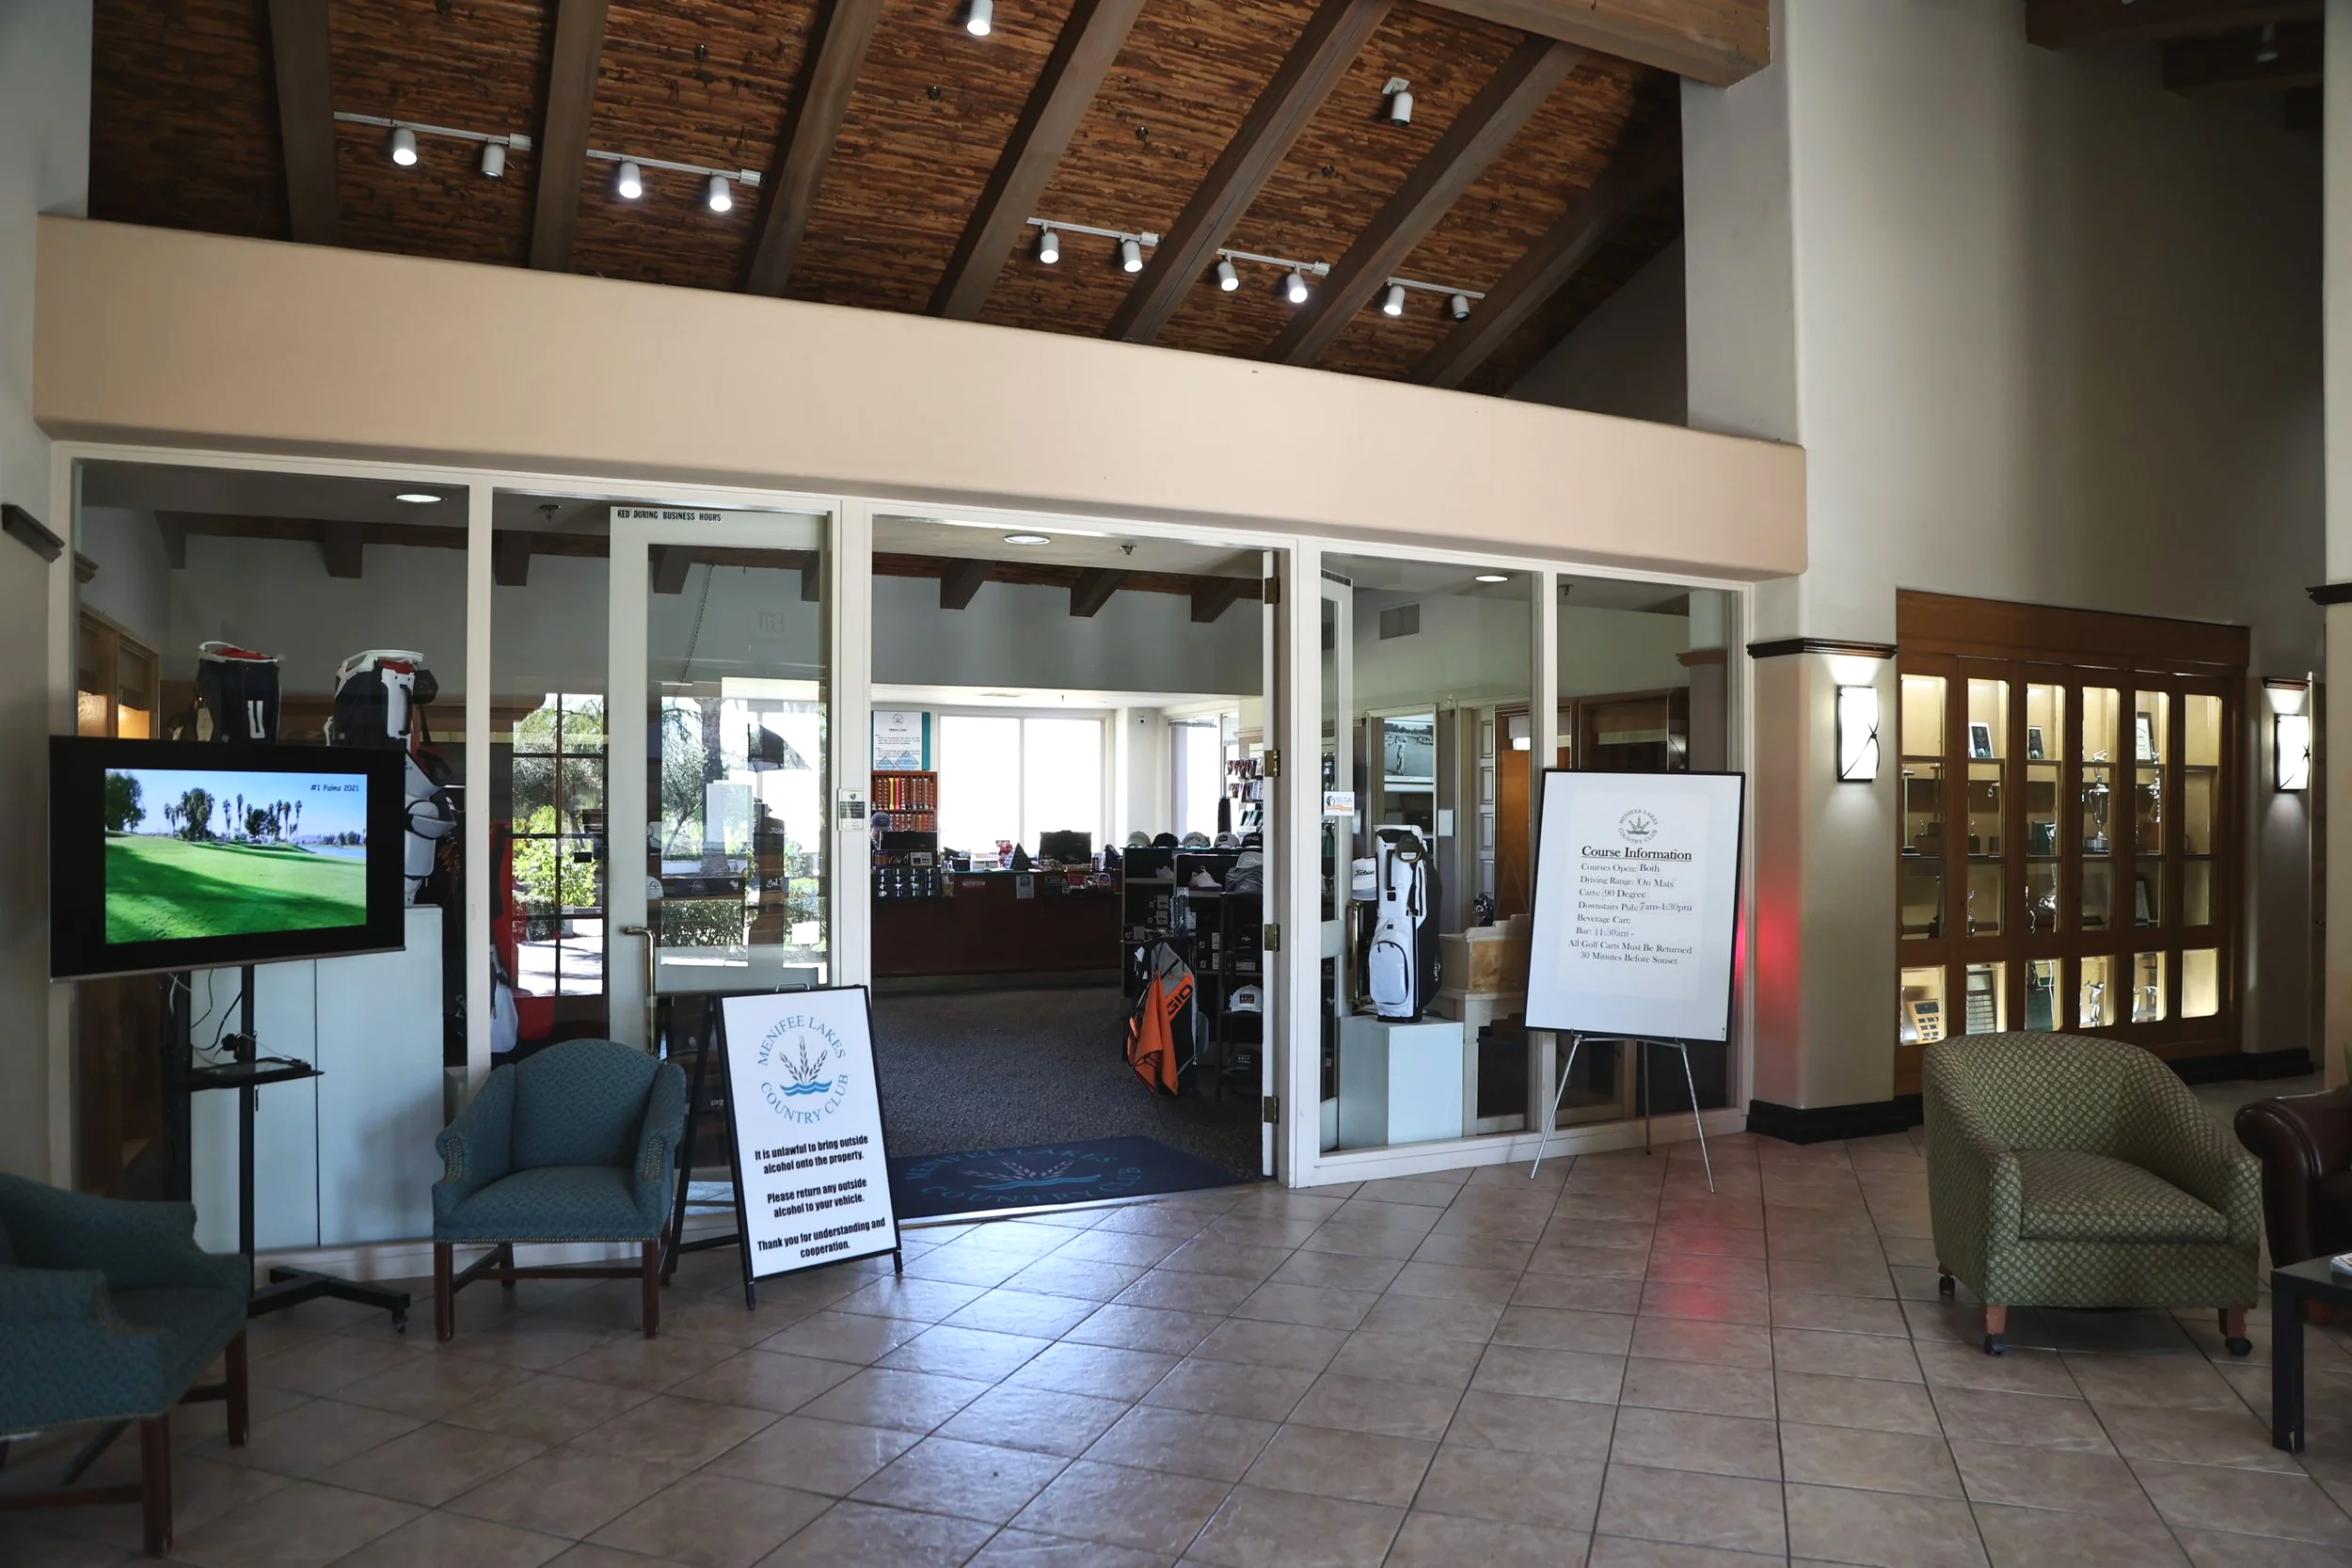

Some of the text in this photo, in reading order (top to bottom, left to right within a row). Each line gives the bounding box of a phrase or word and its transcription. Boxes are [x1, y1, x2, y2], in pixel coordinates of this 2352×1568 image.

[617, 510, 722, 522] KED DURING BUSINESS HOURS
[323, 784, 341, 792] Palms
[343, 784, 359, 792] 2021
[1618, 809, 1658, 826] MENIFEE LAKES
[1618, 828, 1658, 844] COUNTRY CLUB
[1581, 846, 1692, 861] Course Information
[1581, 863, 1660, 873] Courses Open: Both
[1581, 875, 1674, 888] Driving Range: On Mats
[1579, 888, 1646, 899] Carts: 90 Degree
[1578, 901, 1618, 911] Downstairs
[1621, 903, 1638, 911] Pub:
[1577, 914, 1611, 924] Beverage
[1594, 927, 1629, 938] 11:30am
[1581, 940, 1599, 948] Golf
[1600, 941, 1620, 950] Carts
[1622, 942, 1641, 951] Must
[1643, 943, 1654, 952] Be
[1656, 944, 1692, 954] Returned
[1581, 951, 1678, 965] 30 Minutes Before Sunset
[757, 1015, 847, 1067] MENIFEE LAKES
[760, 1074, 849, 1124] COUNTRY CLUB
[755, 1134, 868, 1161] It is unlawful to bring outside
[764, 1150, 864, 1174] alcohol onto the property.
[767, 1178, 867, 1204] Please return any outside
[922, 1166, 1141, 1204] COUNTRY CLUB
[773, 1193, 865, 1217] alcohol to your vehicle.
[757, 1217, 886, 1251] Thank you for understanding and
[800, 1240, 850, 1259] cooperation.
